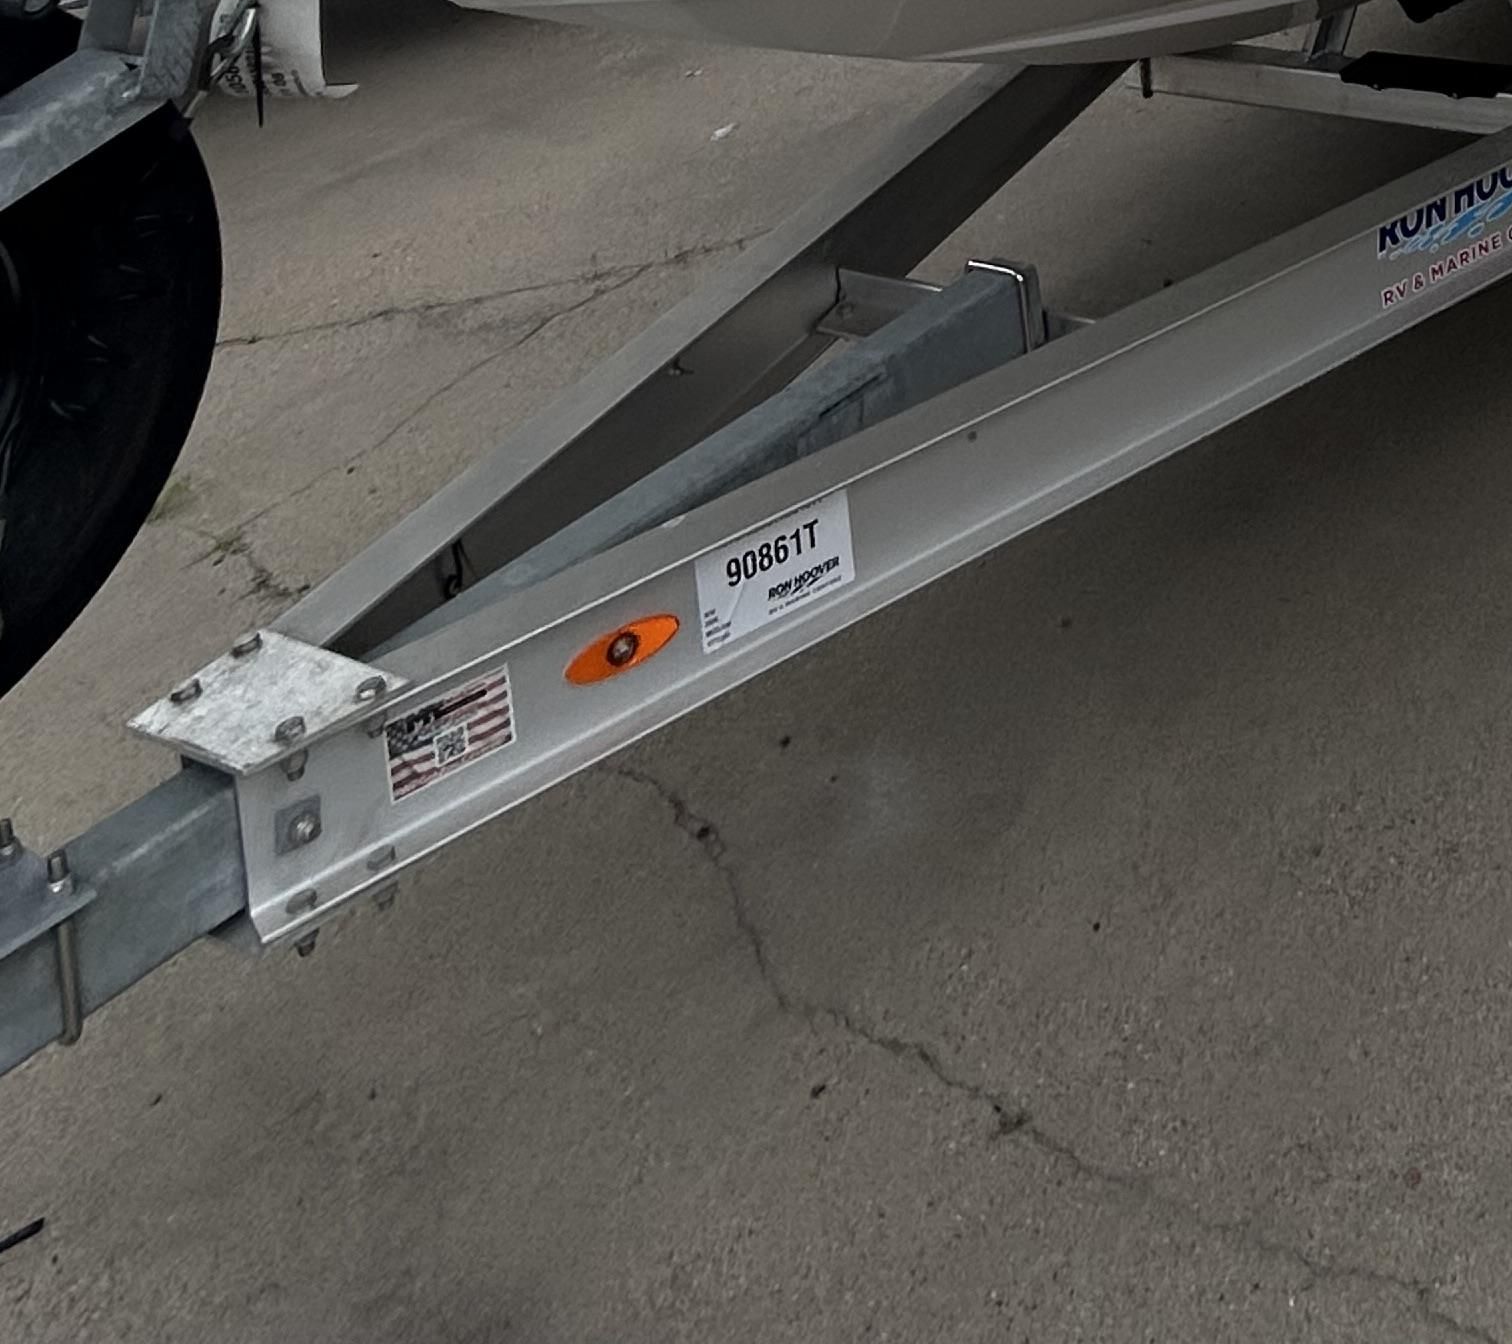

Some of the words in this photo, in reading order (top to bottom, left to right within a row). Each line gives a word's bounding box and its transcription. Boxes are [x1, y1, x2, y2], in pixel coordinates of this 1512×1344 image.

[1381, 281, 1408, 309] RV
[1412, 273, 1425, 291] &
[1429, 232, 1502, 283] MARINE
[726, 518, 819, 588] 90861T
